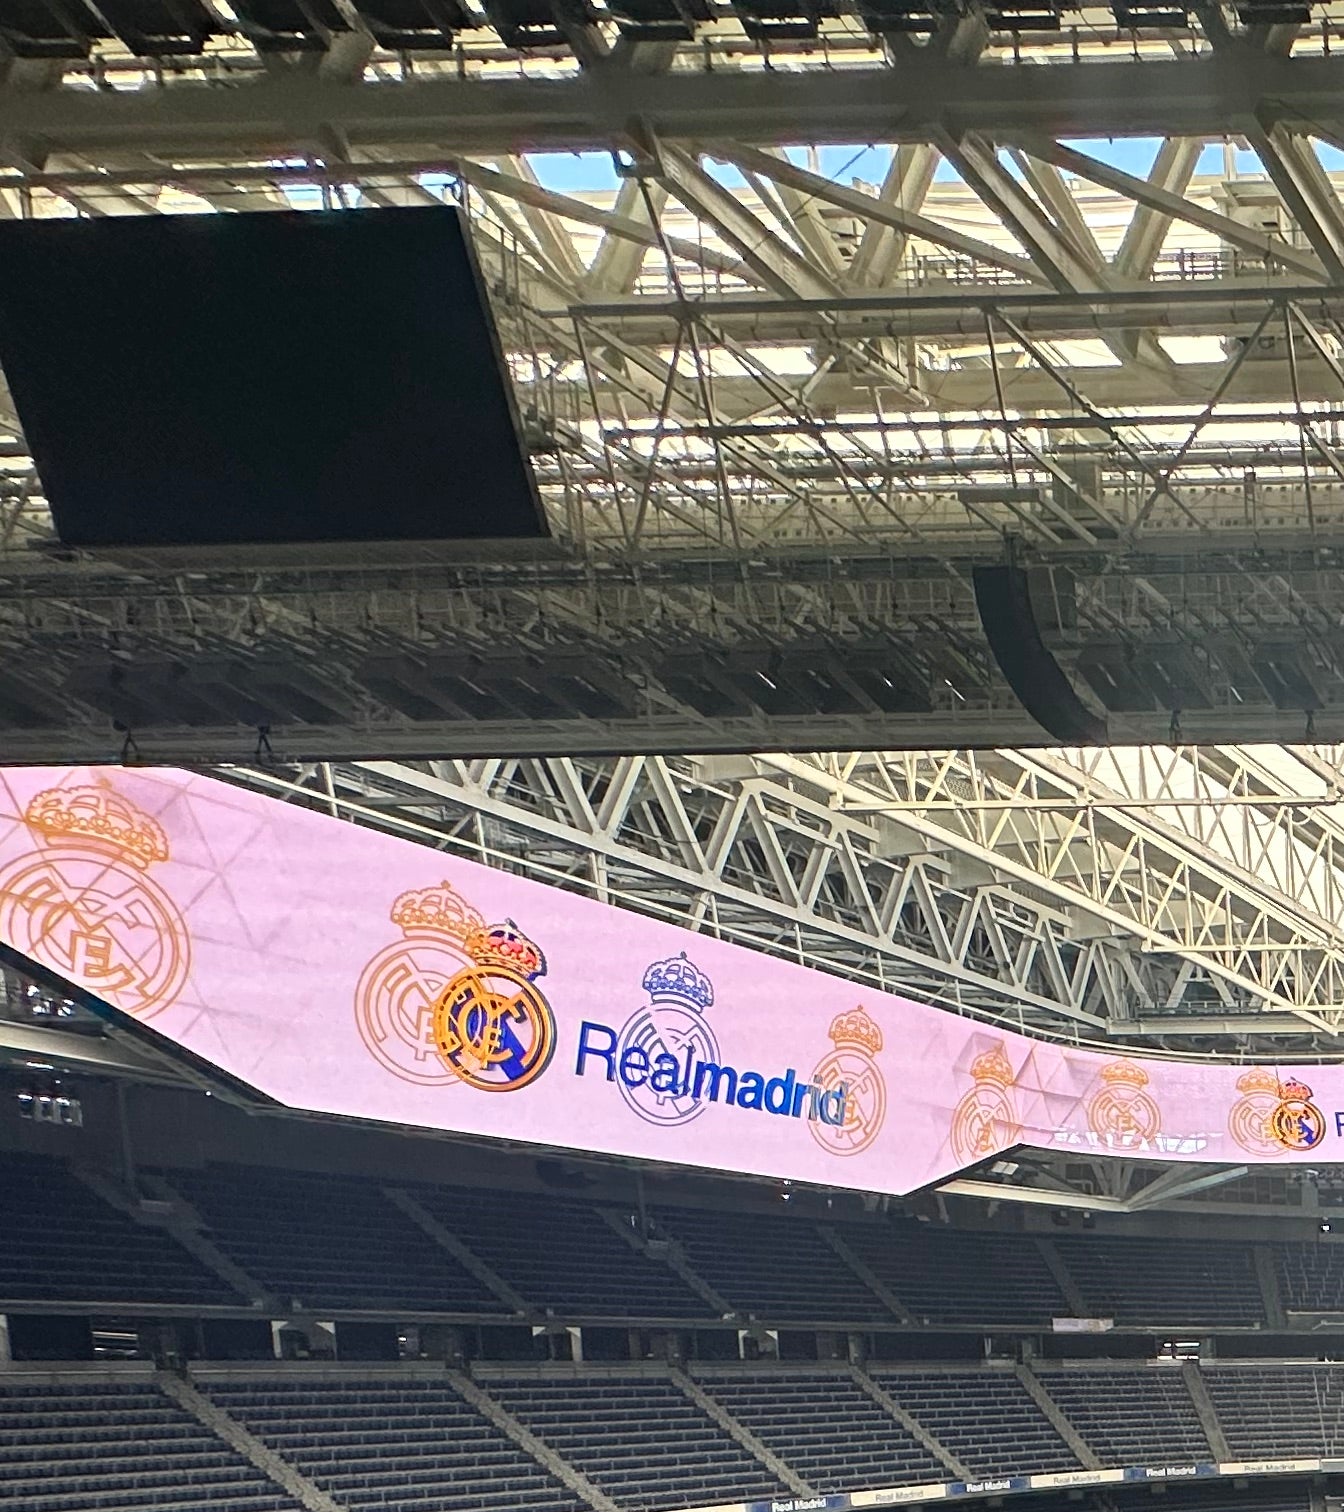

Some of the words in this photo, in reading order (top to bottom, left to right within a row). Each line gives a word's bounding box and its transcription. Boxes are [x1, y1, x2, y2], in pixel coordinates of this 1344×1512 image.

[1146, 1468, 1165, 1477] Real
[1167, 1466, 1196, 1476] Madrid
[1053, 1476, 1070, 1485] Real
[1072, 1474, 1100, 1484] Madrid
[966, 1483, 983, 1493] Real
[985, 1480, 1010, 1491] Madrid
[875, 1492, 893, 1503] Real
[895, 1489, 923, 1500] Madrid
[771, 1501, 792, 1512] Real
[795, 1497, 827, 1511] Madrid
